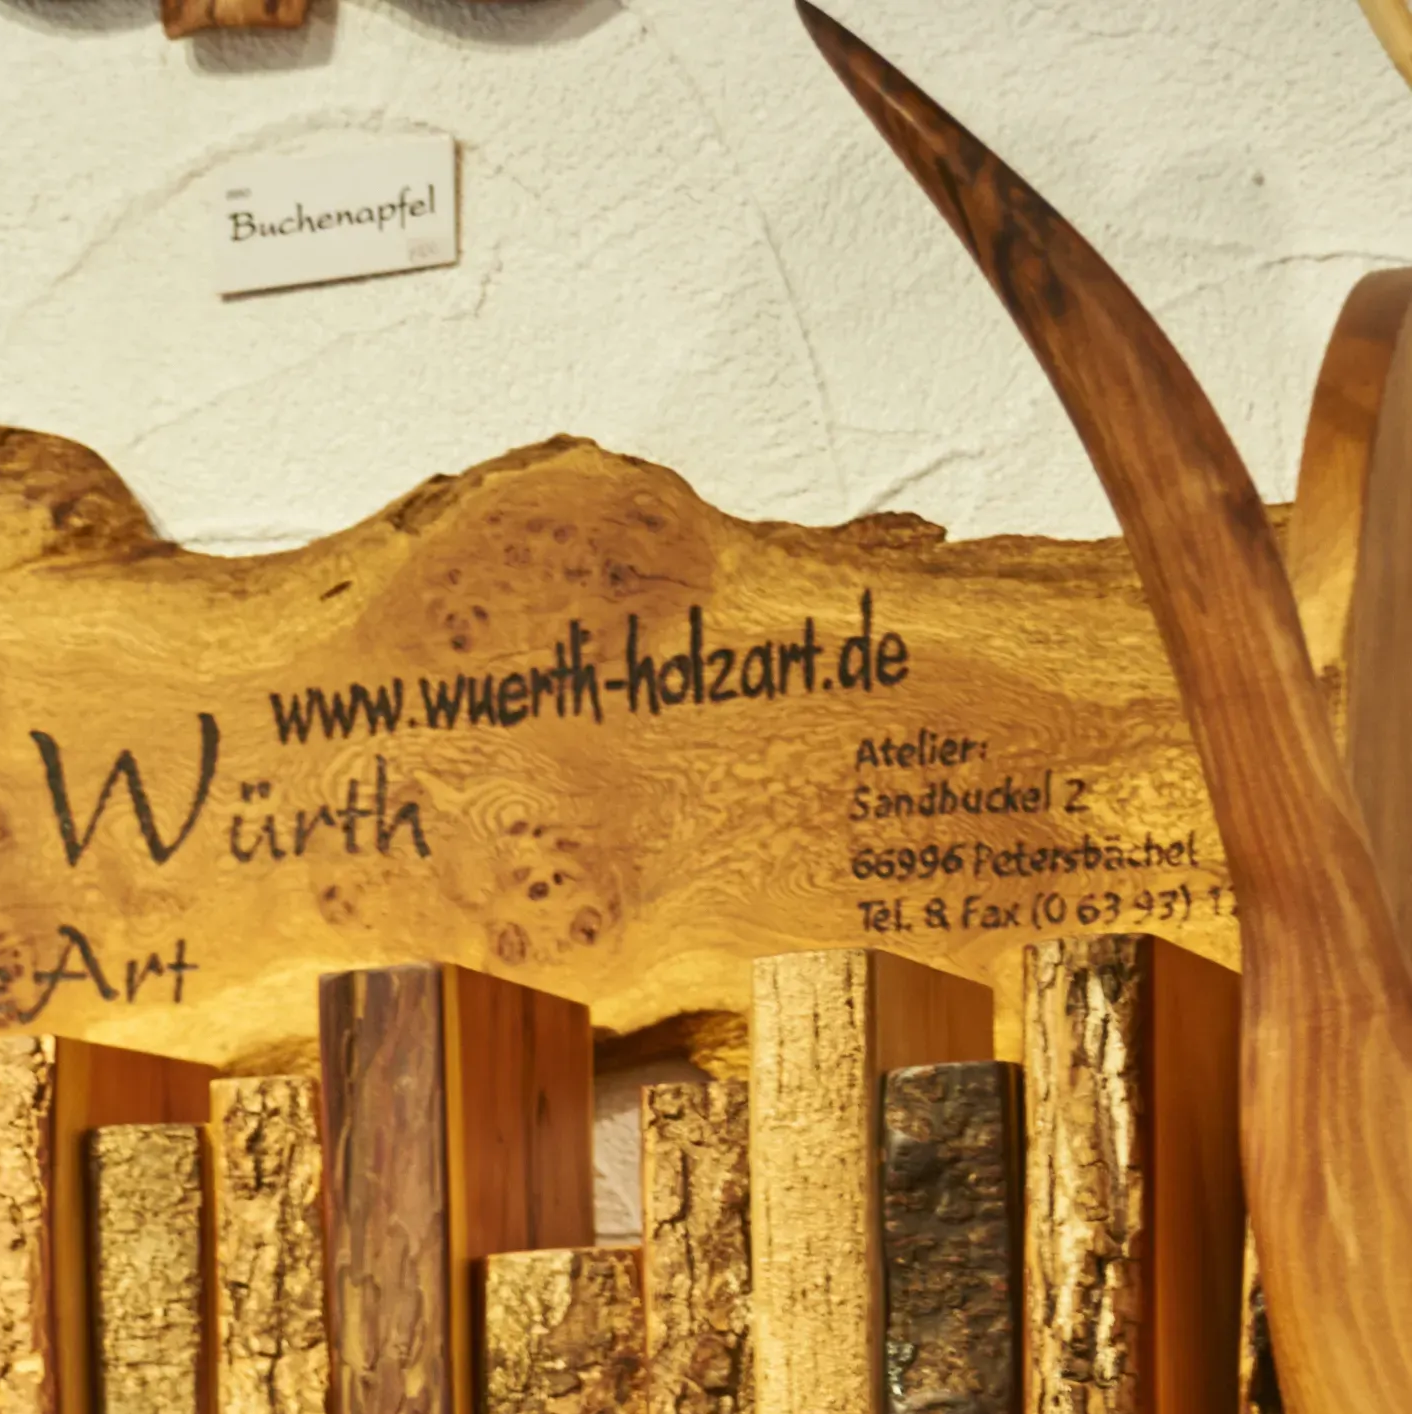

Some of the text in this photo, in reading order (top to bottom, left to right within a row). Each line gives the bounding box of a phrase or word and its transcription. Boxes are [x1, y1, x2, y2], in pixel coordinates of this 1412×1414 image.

[228, 183, 435, 242] Buchenapfel
[270, 588, 909, 744] www.wuerth-holzart.de
[855, 728, 988, 770] Atelier:
[31, 712, 432, 868] Würth
[849, 769, 1091, 820] Sandbuckel 2
[852, 843, 965, 880] 66996
[924, 898, 949, 931] &
[962, 894, 1020, 929] Fax
[1076, 892, 1121, 926] 63
